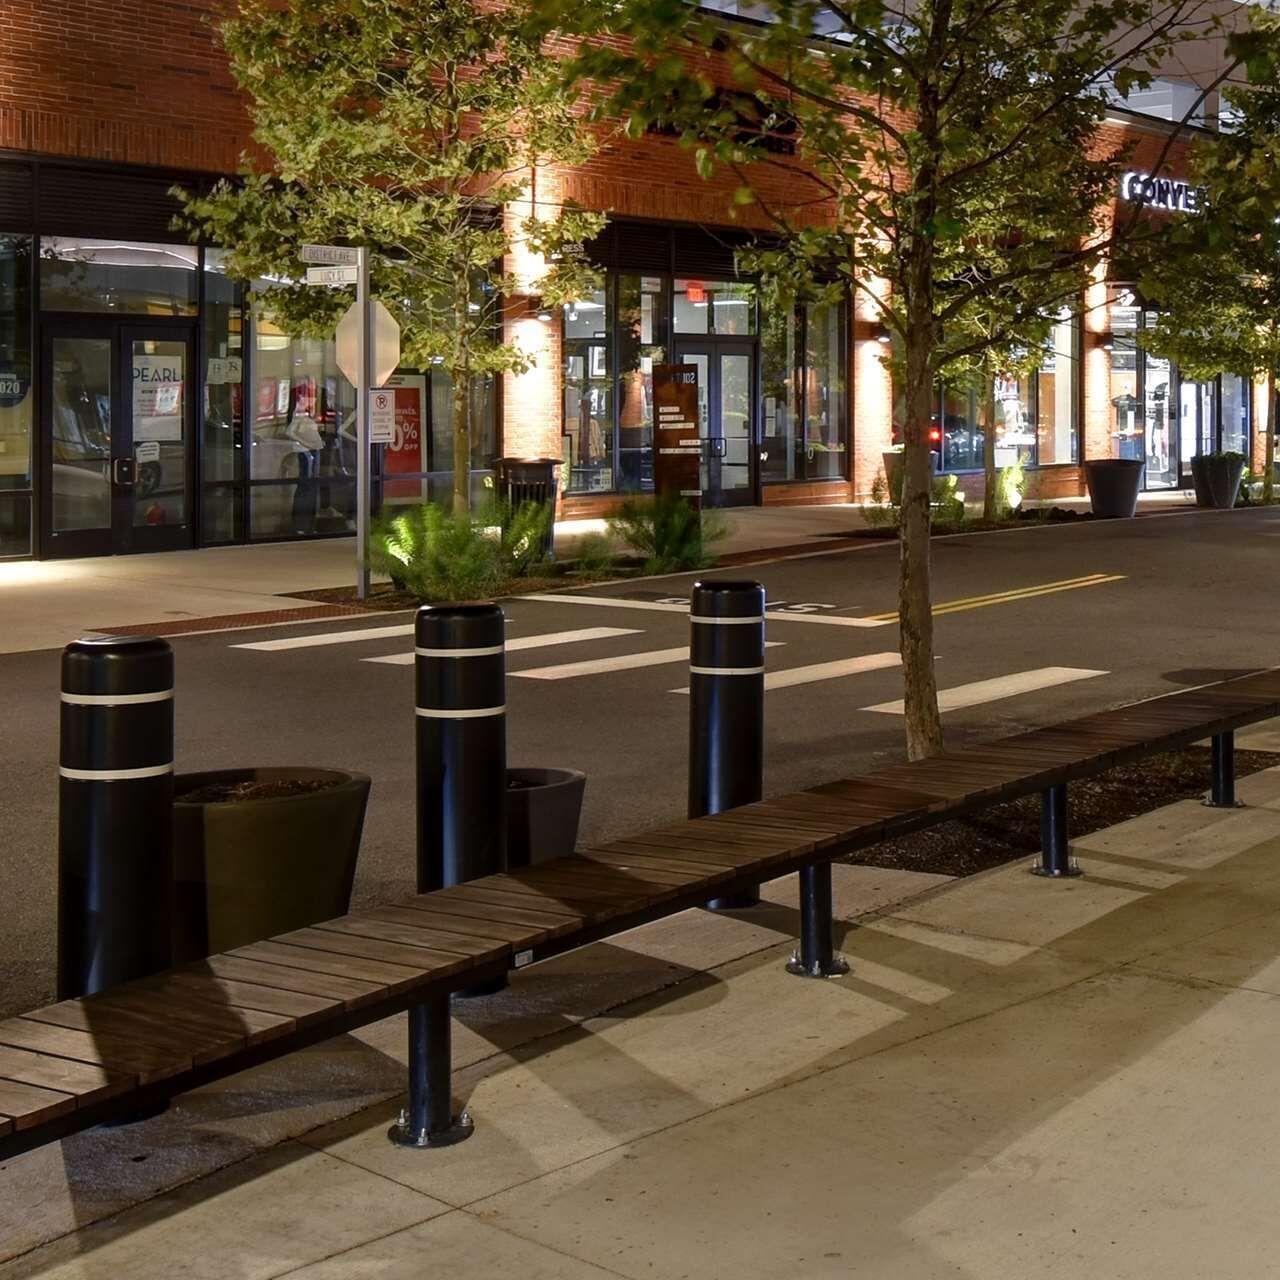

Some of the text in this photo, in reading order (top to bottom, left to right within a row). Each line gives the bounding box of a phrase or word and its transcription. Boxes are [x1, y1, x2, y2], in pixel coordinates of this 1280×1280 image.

[1124, 173, 1206, 212] CONVE
[131, 367, 180, 382] PEARL
[403, 443, 418, 451] OFF
